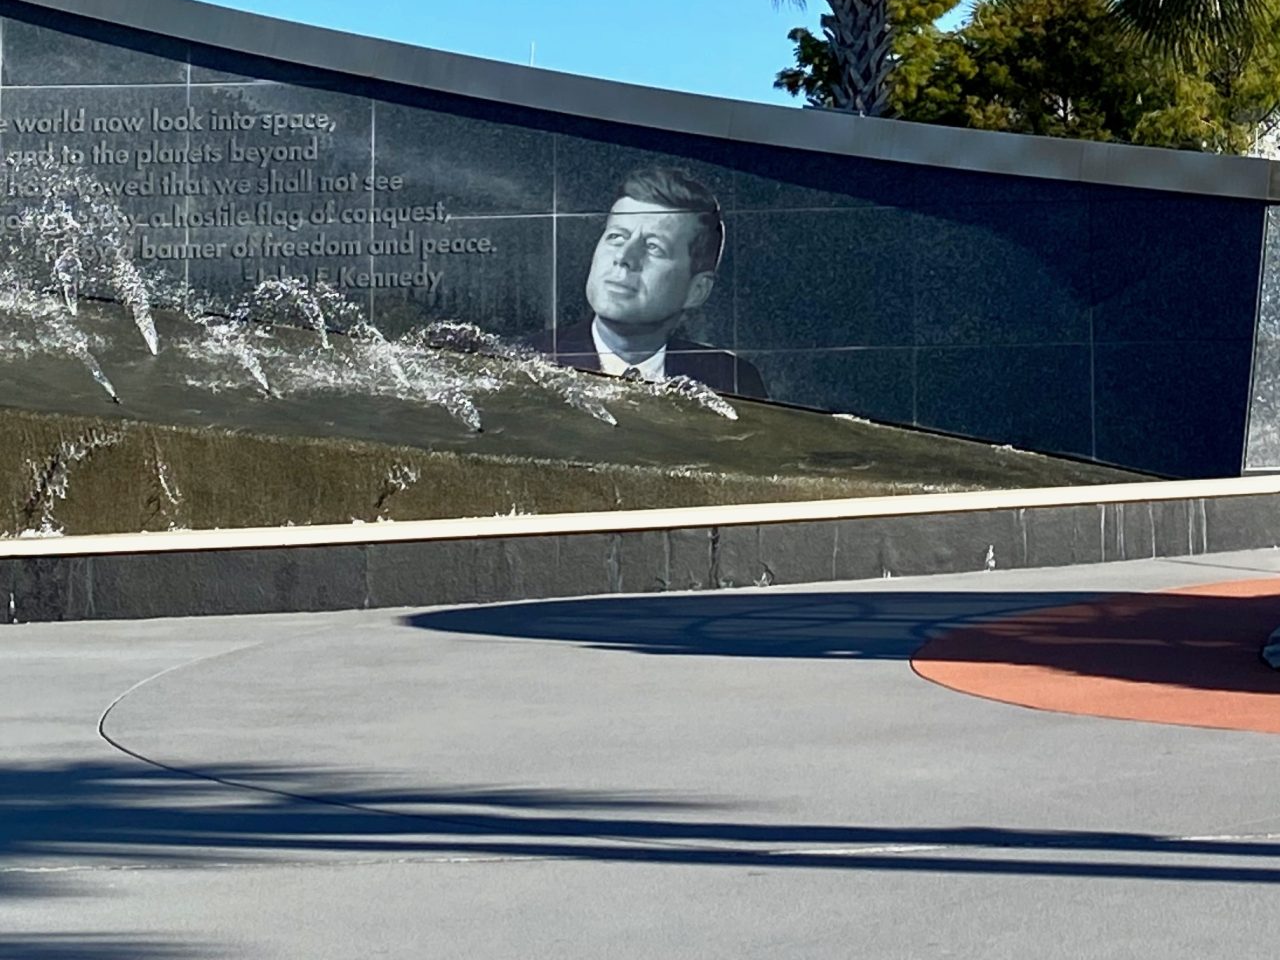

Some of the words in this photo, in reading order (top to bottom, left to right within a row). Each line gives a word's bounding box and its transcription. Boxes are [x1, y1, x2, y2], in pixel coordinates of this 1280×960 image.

[14, 108, 86, 133] world
[92, 116, 145, 133] now
[151, 107, 203, 132] look
[211, 108, 255, 131] into
[261, 112, 336, 136] space,
[7, 141, 55, 164] and
[61, 145, 86, 164] to
[91, 140, 130, 165] the
[134, 139, 222, 171] planets
[229, 136, 319, 168] beyond
[161, 171, 210, 196] that
[212, 177, 249, 195] we
[258, 169, 313, 194] shall
[320, 171, 357, 192] not
[363, 175, 404, 192] see
[150, 210, 168, 228] a
[173, 203, 250, 228] hostile
[257, 201, 304, 231] flag
[310, 200, 336, 225] of
[341, 200, 451, 229] conquest,
[140, 235, 226, 260] banner
[232, 233, 256, 258] of
[264, 231, 361, 257] freedom
[368, 229, 415, 255] and
[422, 237, 498, 260] peace.
[338, 263, 444, 291] Kennedy
